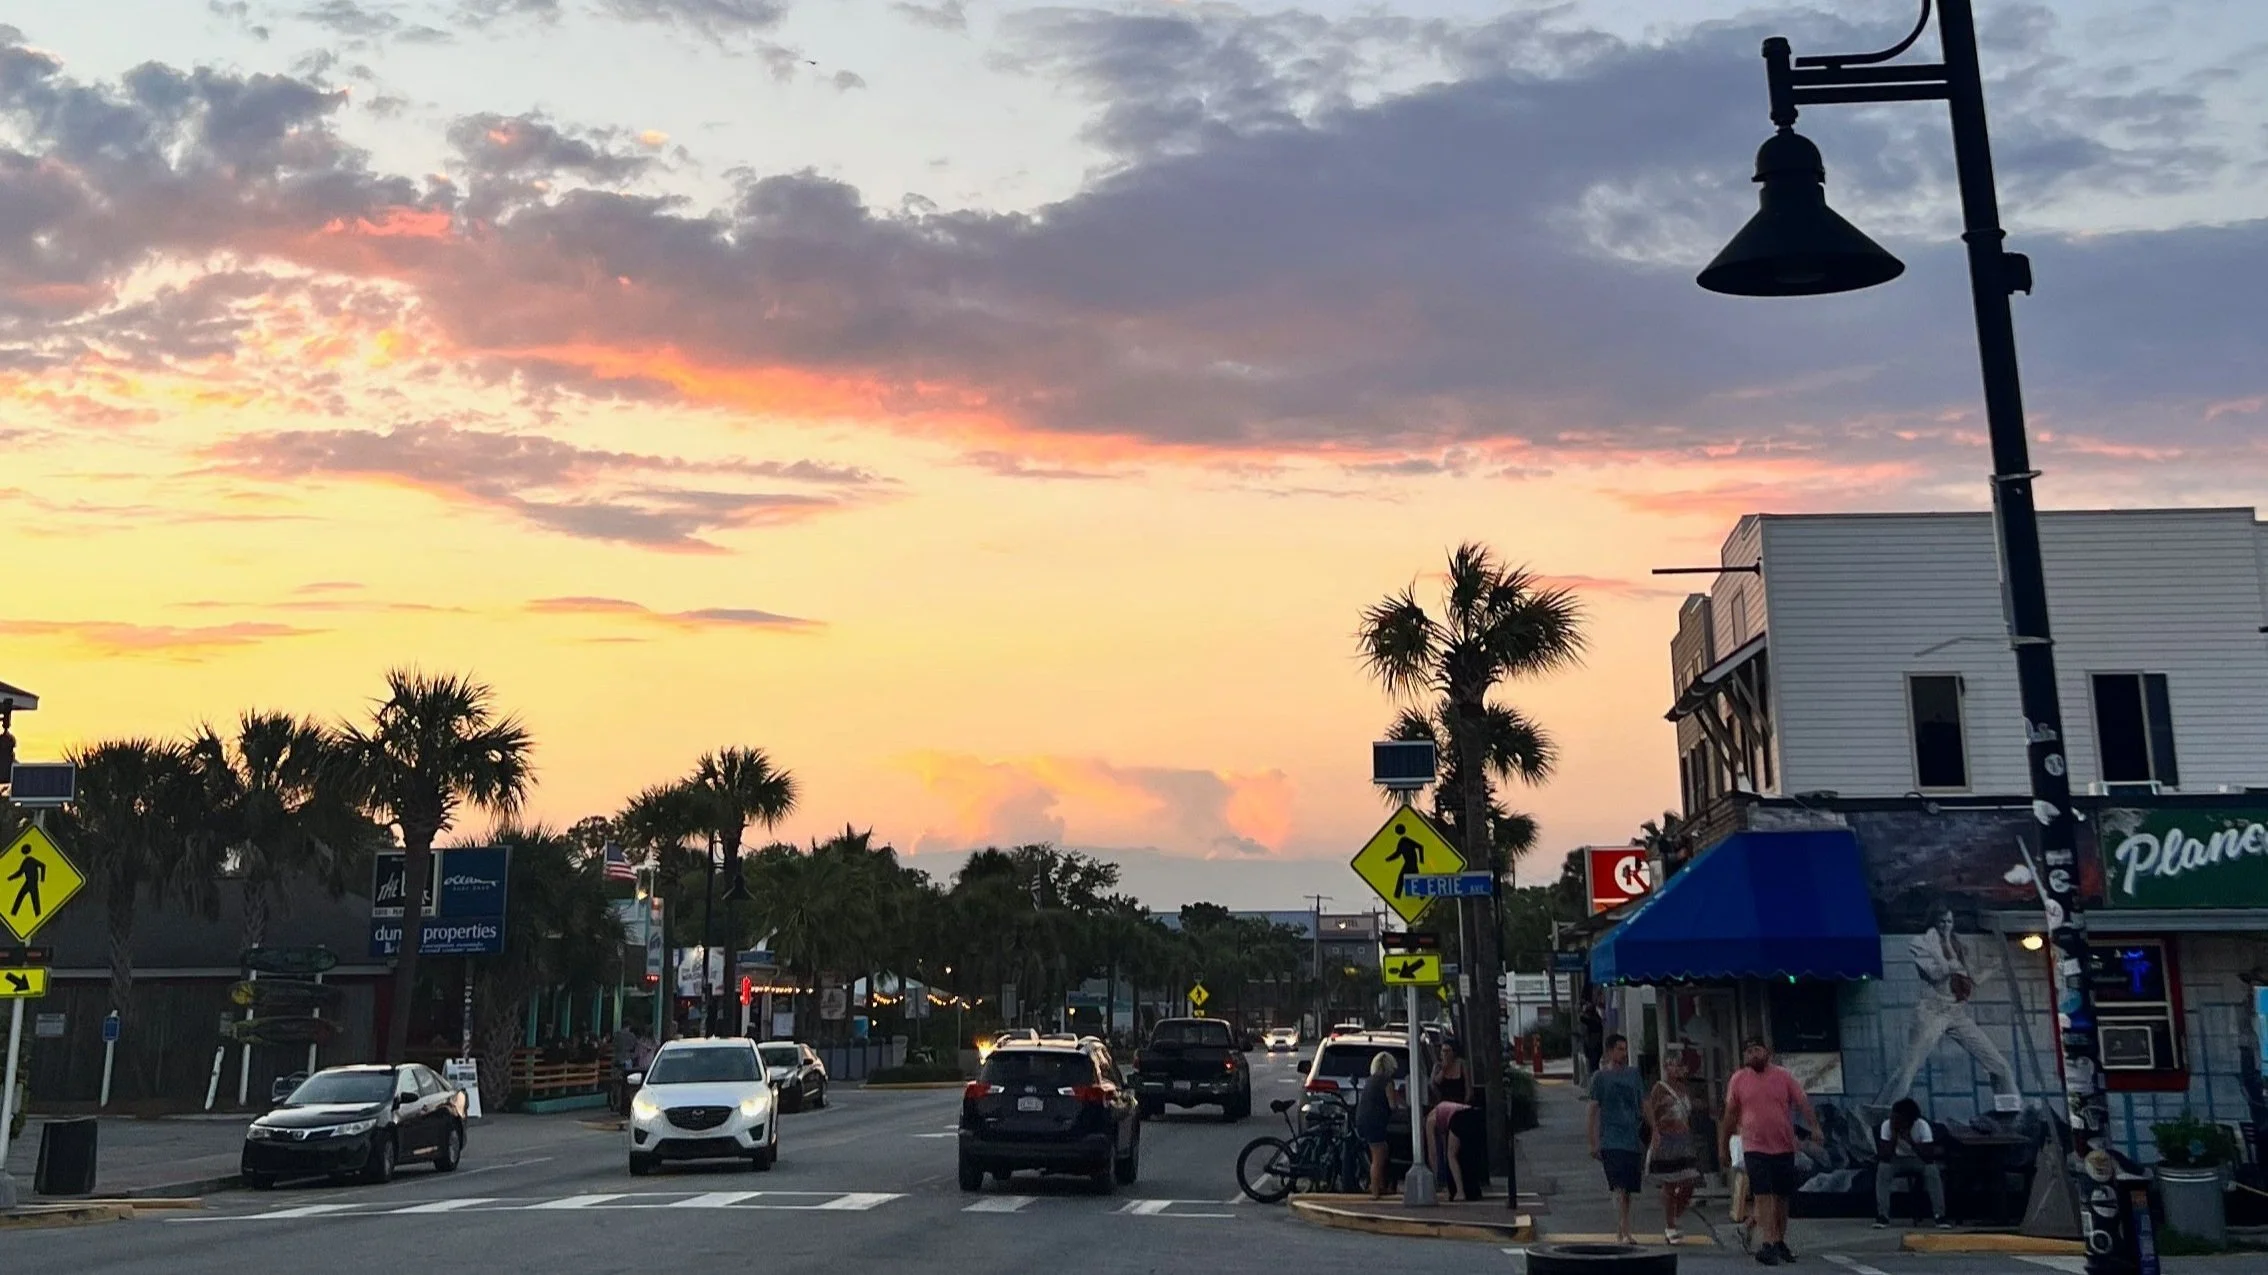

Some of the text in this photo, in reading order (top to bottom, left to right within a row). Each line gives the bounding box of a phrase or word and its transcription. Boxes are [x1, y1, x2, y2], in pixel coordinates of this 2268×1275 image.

[2115, 823, 2268, 895] Plane
[1411, 877, 1485, 895] E ERIE AVE
[375, 923, 497, 943] dun properties
